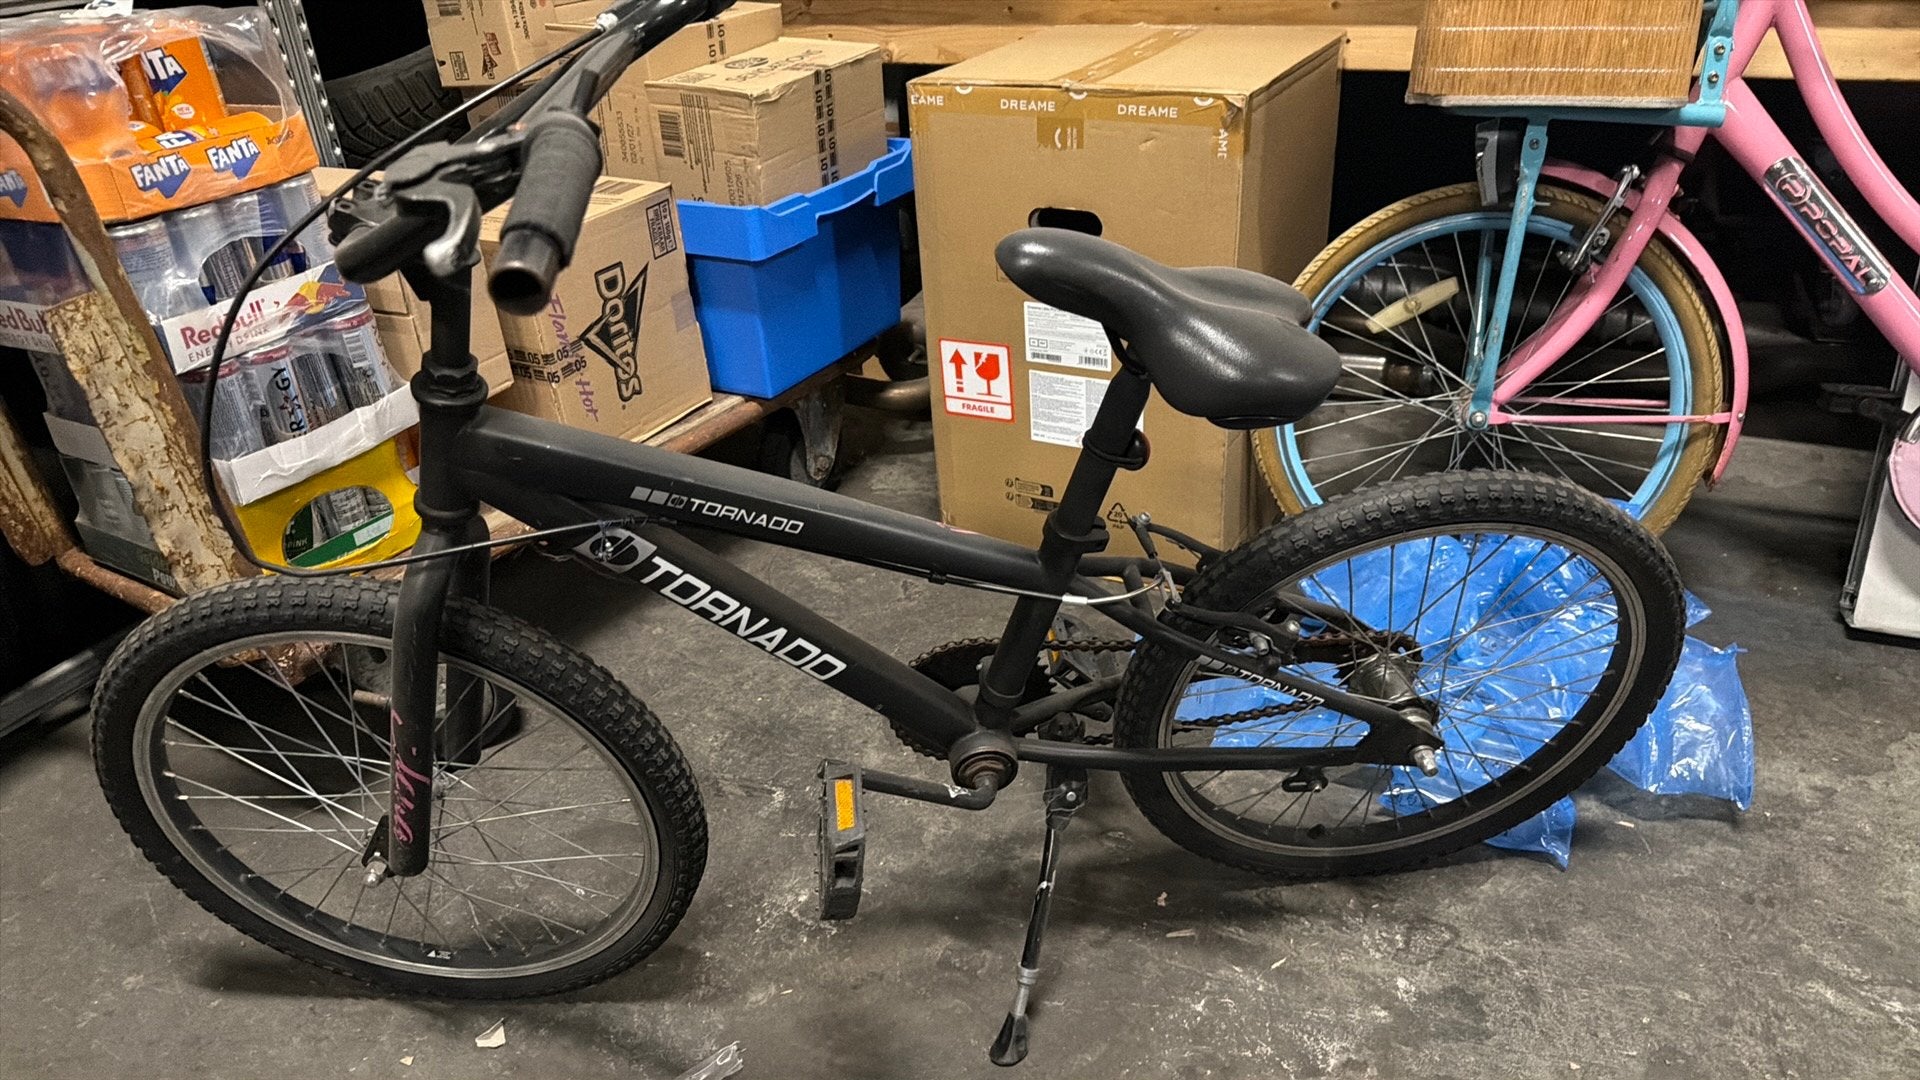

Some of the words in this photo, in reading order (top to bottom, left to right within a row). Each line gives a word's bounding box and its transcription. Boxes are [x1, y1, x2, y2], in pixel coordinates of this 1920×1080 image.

[717, 23, 725, 38] 01
[708, 44, 717, 58] 01
[1000, 98, 1056, 112] DREAME
[1117, 103, 1179, 119] DREAME
[206, 136, 261, 170] FANTA
[130, 153, 191, 190] FANTA
[594, 260, 643, 402] Doritos
[556, 345, 571, 362] 05
[574, 356, 587, 373] 05
[961, 402, 996, 414] FRAGILE
[687, 497, 804, 535] TORNADO
[640, 555, 848, 682] TORNADO
[1236, 669, 1325, 707] TORNADO
